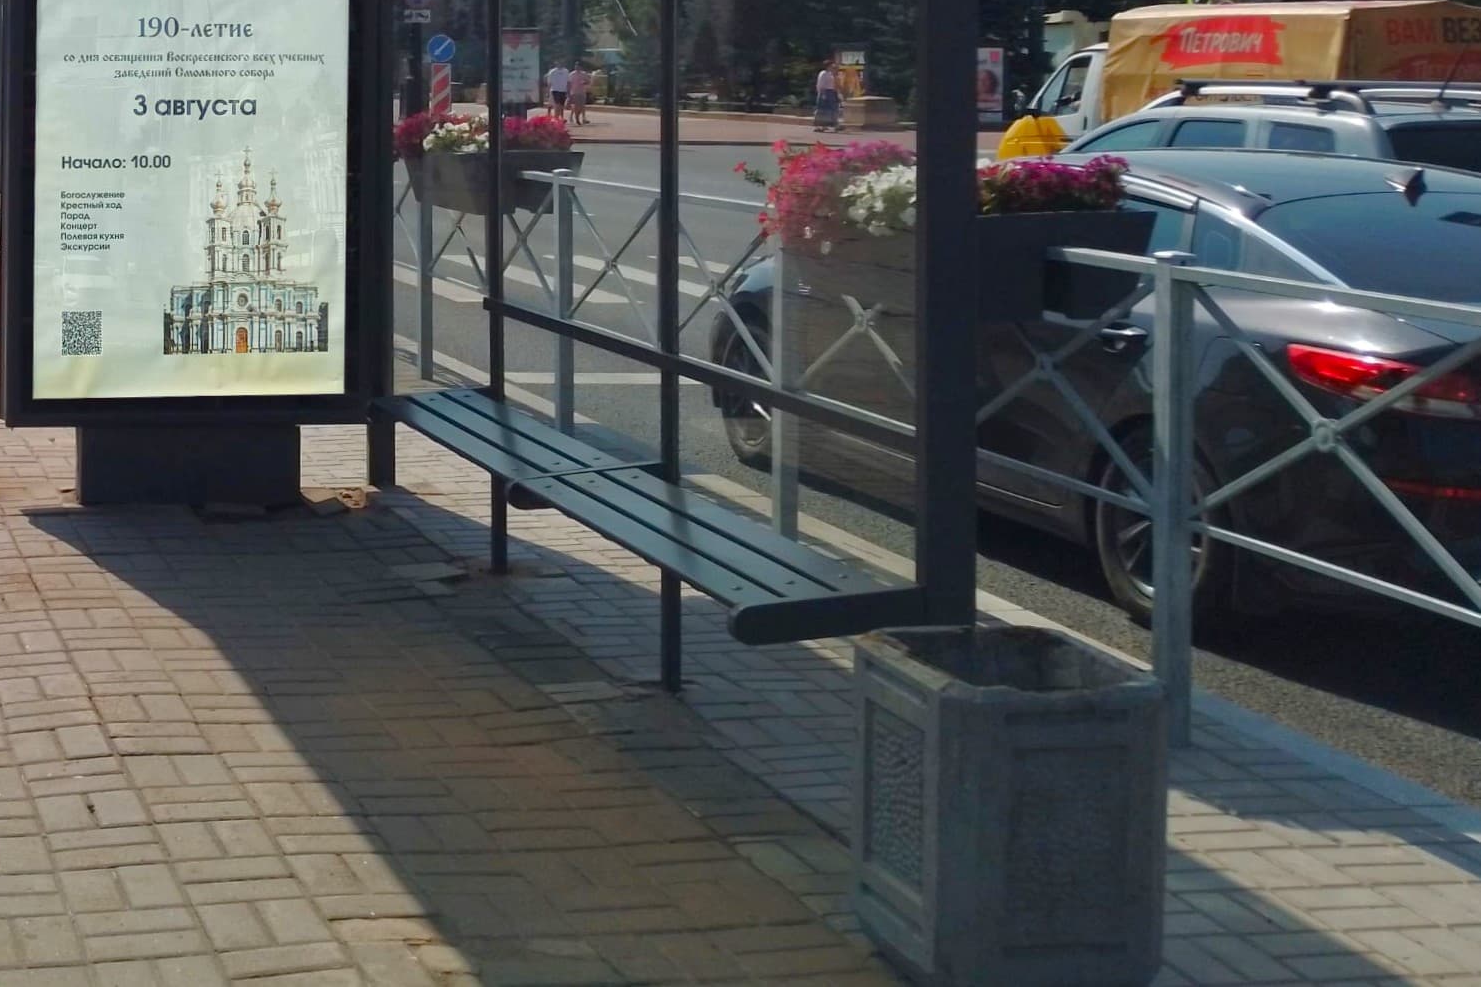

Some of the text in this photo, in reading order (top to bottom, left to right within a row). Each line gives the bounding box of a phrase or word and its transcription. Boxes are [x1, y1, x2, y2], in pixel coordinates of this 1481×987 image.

[63, 53, 76, 62] со
[133, 94, 258, 121] 3 августа
[61, 155, 171, 169] Начало: 10.00
[60, 190, 126, 200] Богослужение
[60, 201, 123, 210] Крестный ход
[60, 221, 98, 231] Концерт
[60, 232, 125, 242] Полевая кухня
[60, 242, 111, 252] Экскурсии
